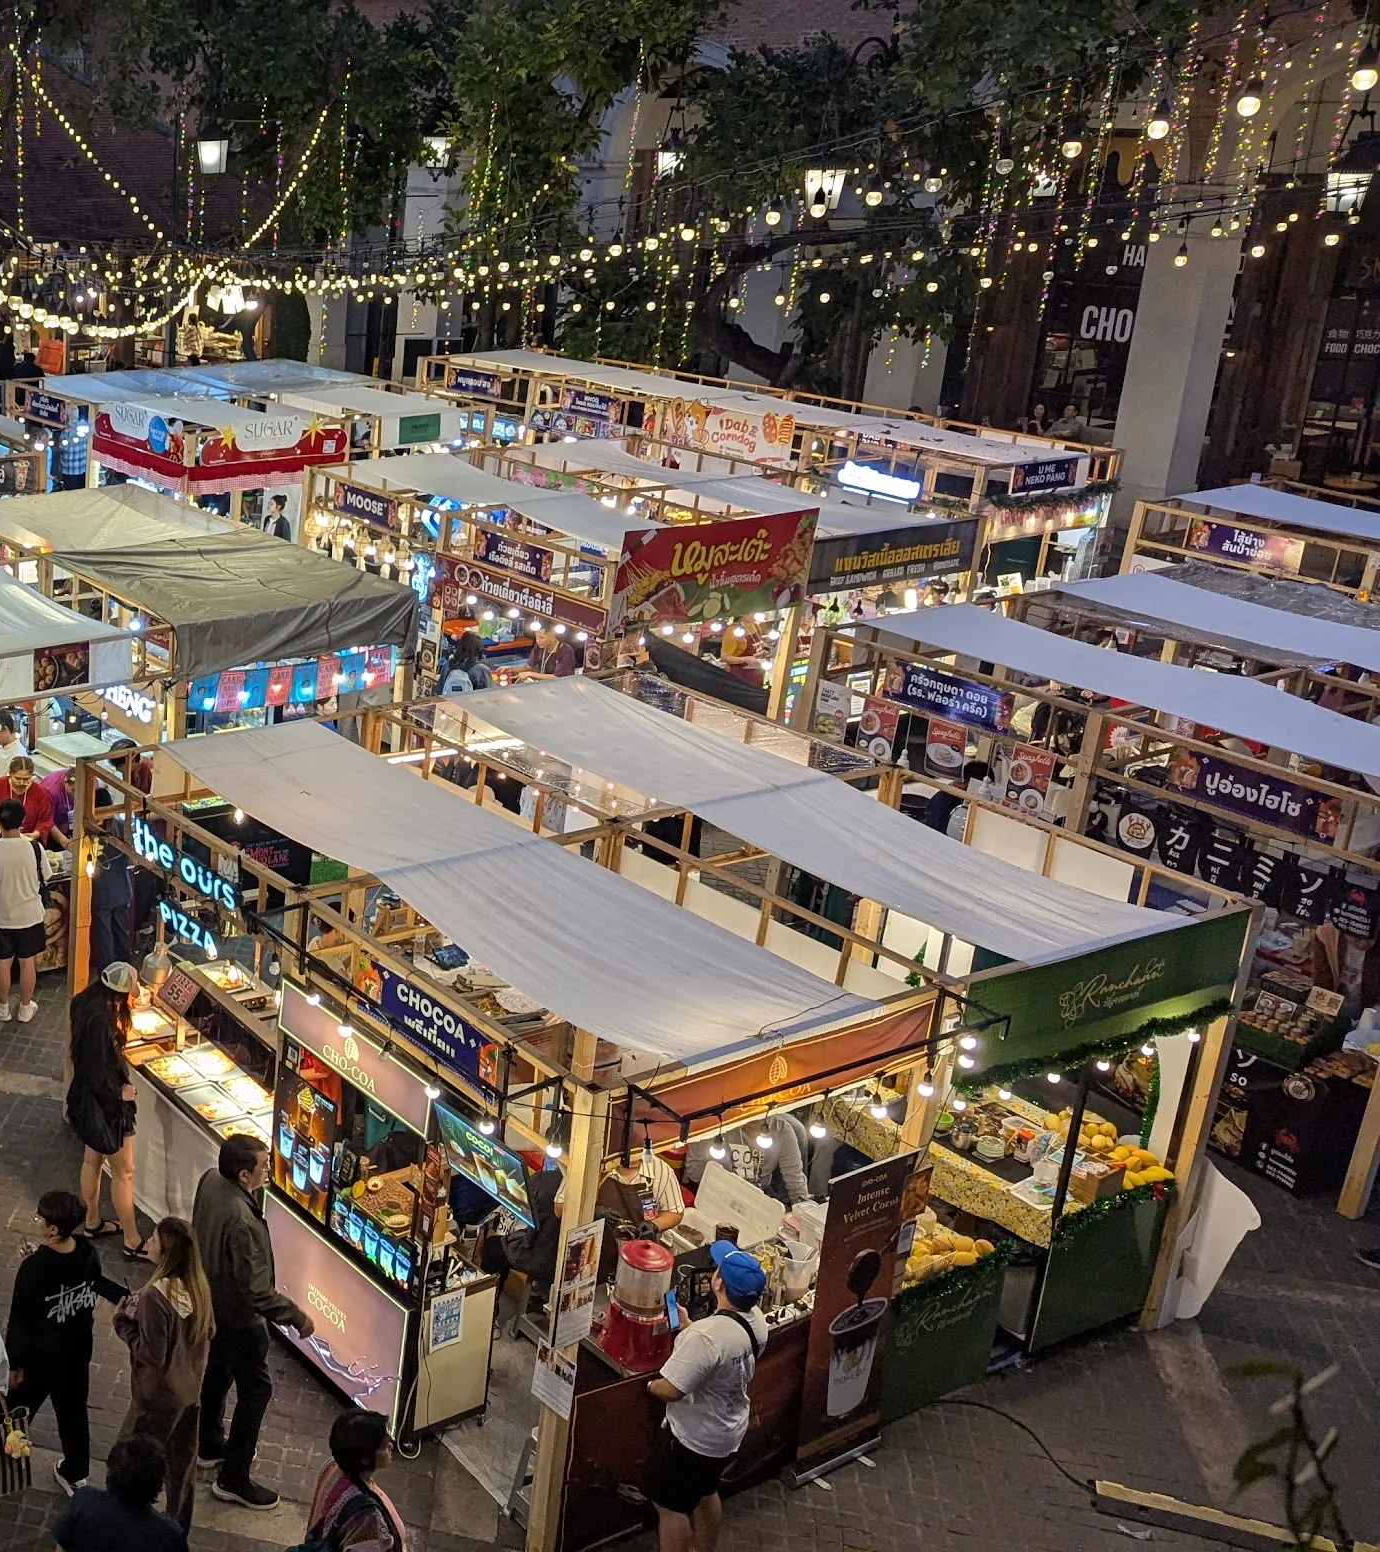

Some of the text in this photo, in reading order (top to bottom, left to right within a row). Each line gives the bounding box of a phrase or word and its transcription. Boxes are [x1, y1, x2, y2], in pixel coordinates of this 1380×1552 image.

[1325, 342, 1348, 354] FOOD
[115, 405, 145, 428] SUGAR
[724, 418, 749, 433] Dab
[244, 420, 293, 439] SUGAR
[711, 432, 756, 453] Corndog
[1025, 472, 1066, 486] NEKO PANG
[346, 491, 384, 517] MOOSE
[671, 528, 773, 588] หมูสะเต๊ะ
[829, 575, 846, 587] BEEF
[845, 570, 877, 585] SANDWICH
[882, 566, 904, 579] GRILLED
[907, 563, 925, 575] FRESH
[222, 676, 241, 685] CAKE
[272, 671, 290, 680] CAKE
[966, 690, 989, 705] ดอย
[931, 727, 962, 740] Spaghetti
[1017, 751, 1053, 767] Spaghetti
[1205, 771, 1303, 818] ปูอ่องไฮโซ
[132, 817, 175, 869] the
[1166, 826, 1191, 850] カ
[160, 901, 219, 959] PIZZA
[175, 973, 194, 993] PIZZA
[396, 983, 466, 1045] CHOCOA
[322, 1044, 376, 1093] CHO-COA
[1229, 1072, 1248, 1086] so
[857, 1186, 890, 1205] Intense
[843, 1206, 870, 1224] Velvet
[307, 1290, 347, 1334] COCOA
